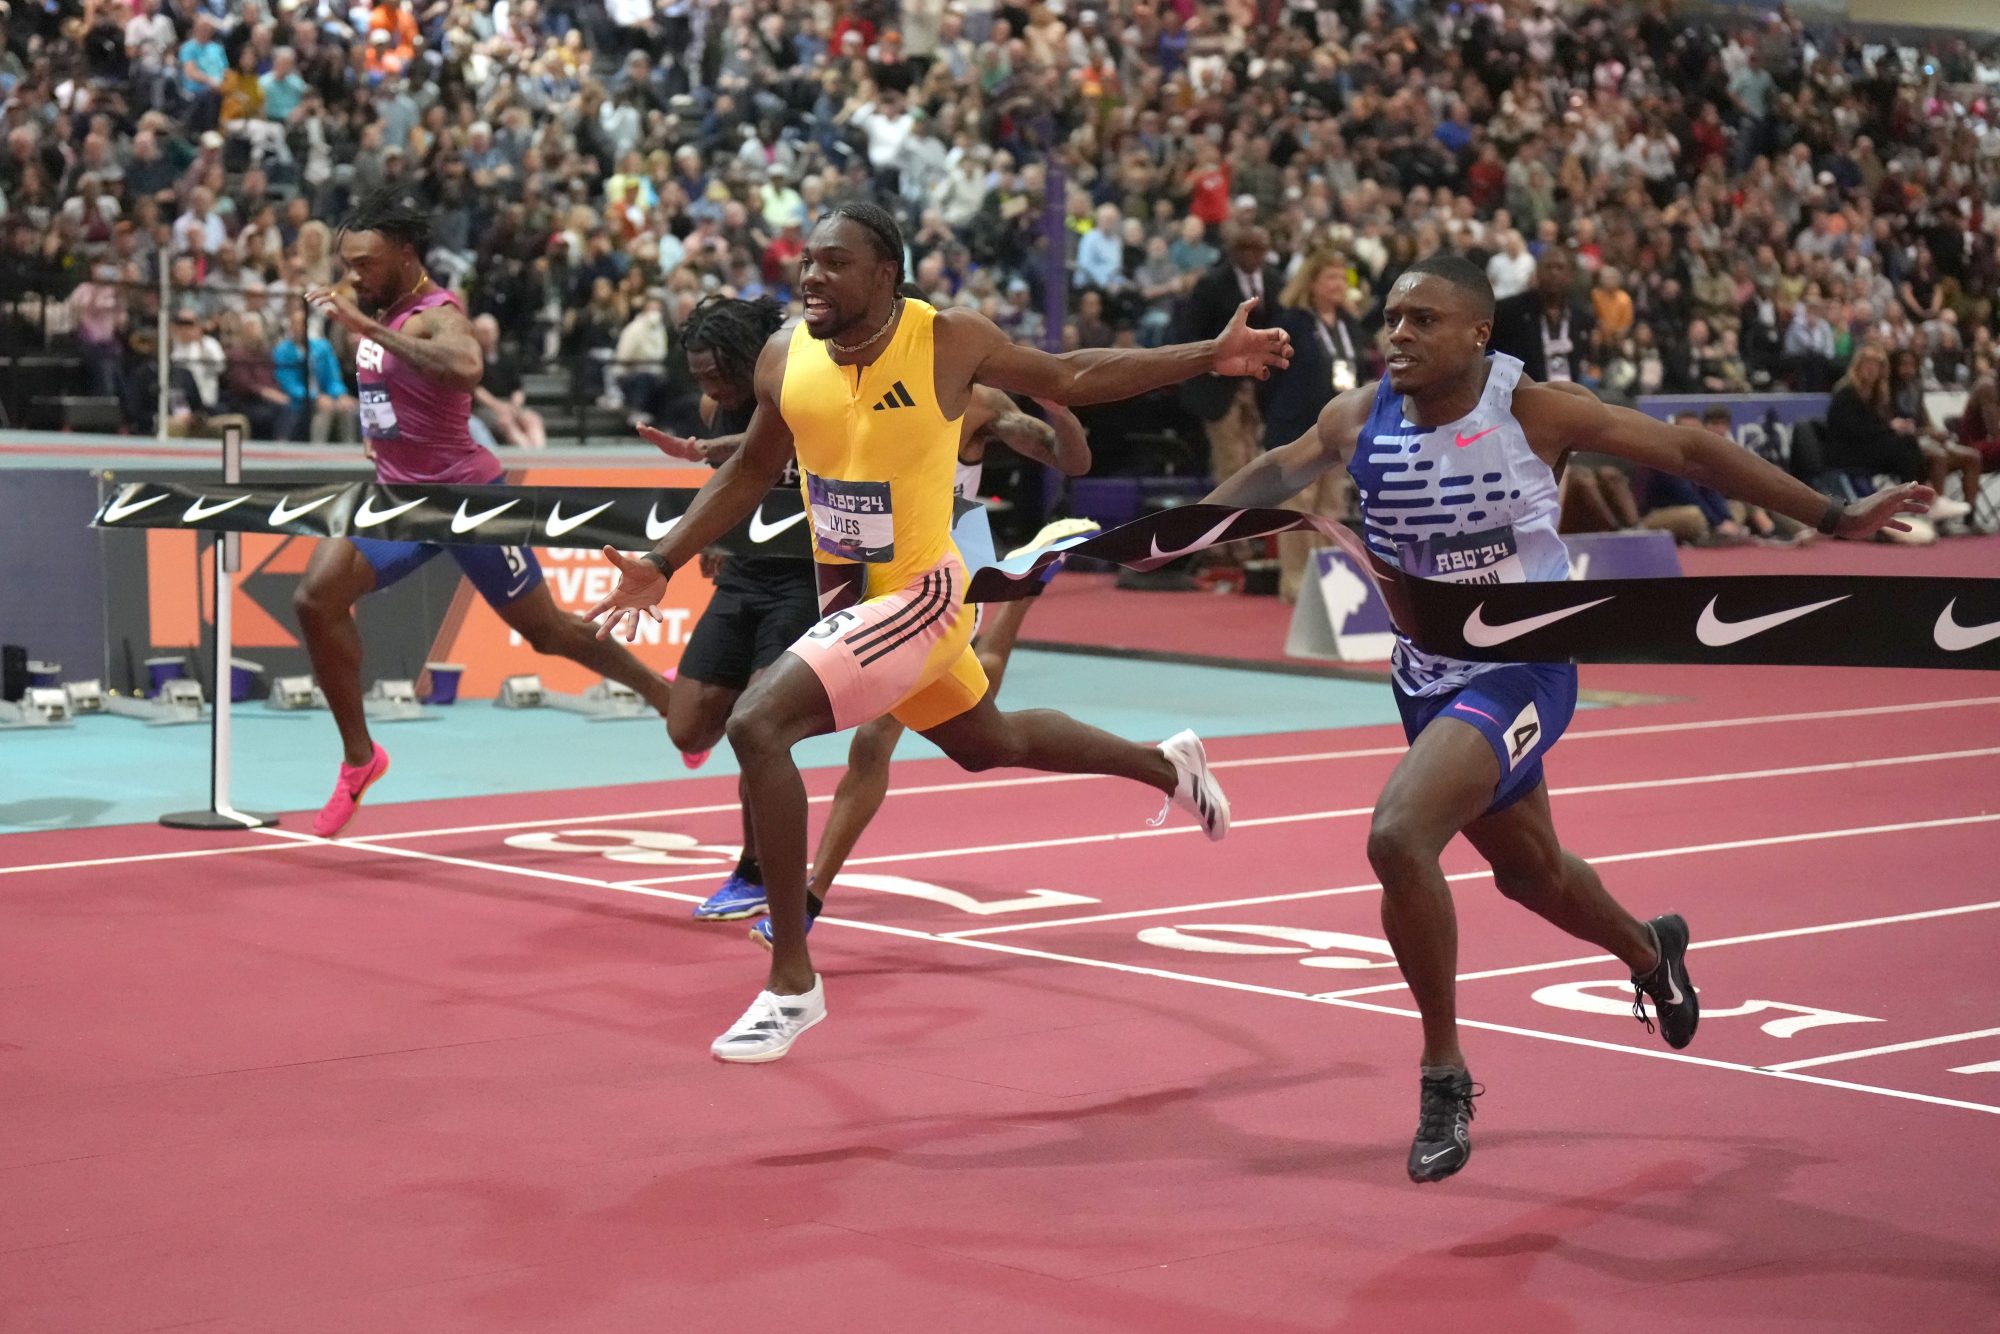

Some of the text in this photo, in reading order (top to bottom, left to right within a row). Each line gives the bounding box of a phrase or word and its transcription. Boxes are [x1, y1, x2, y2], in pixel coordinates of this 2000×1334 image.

[356, 337, 385, 374] SA
[827, 491, 884, 512] ABQ'24
[830, 514, 860, 535] LYLES
[1436, 542, 1508, 572] ABQ'24
[808, 610, 855, 639] 5
[1512, 722, 1539, 760] 4
[1530, 979, 1888, 1038] 5
